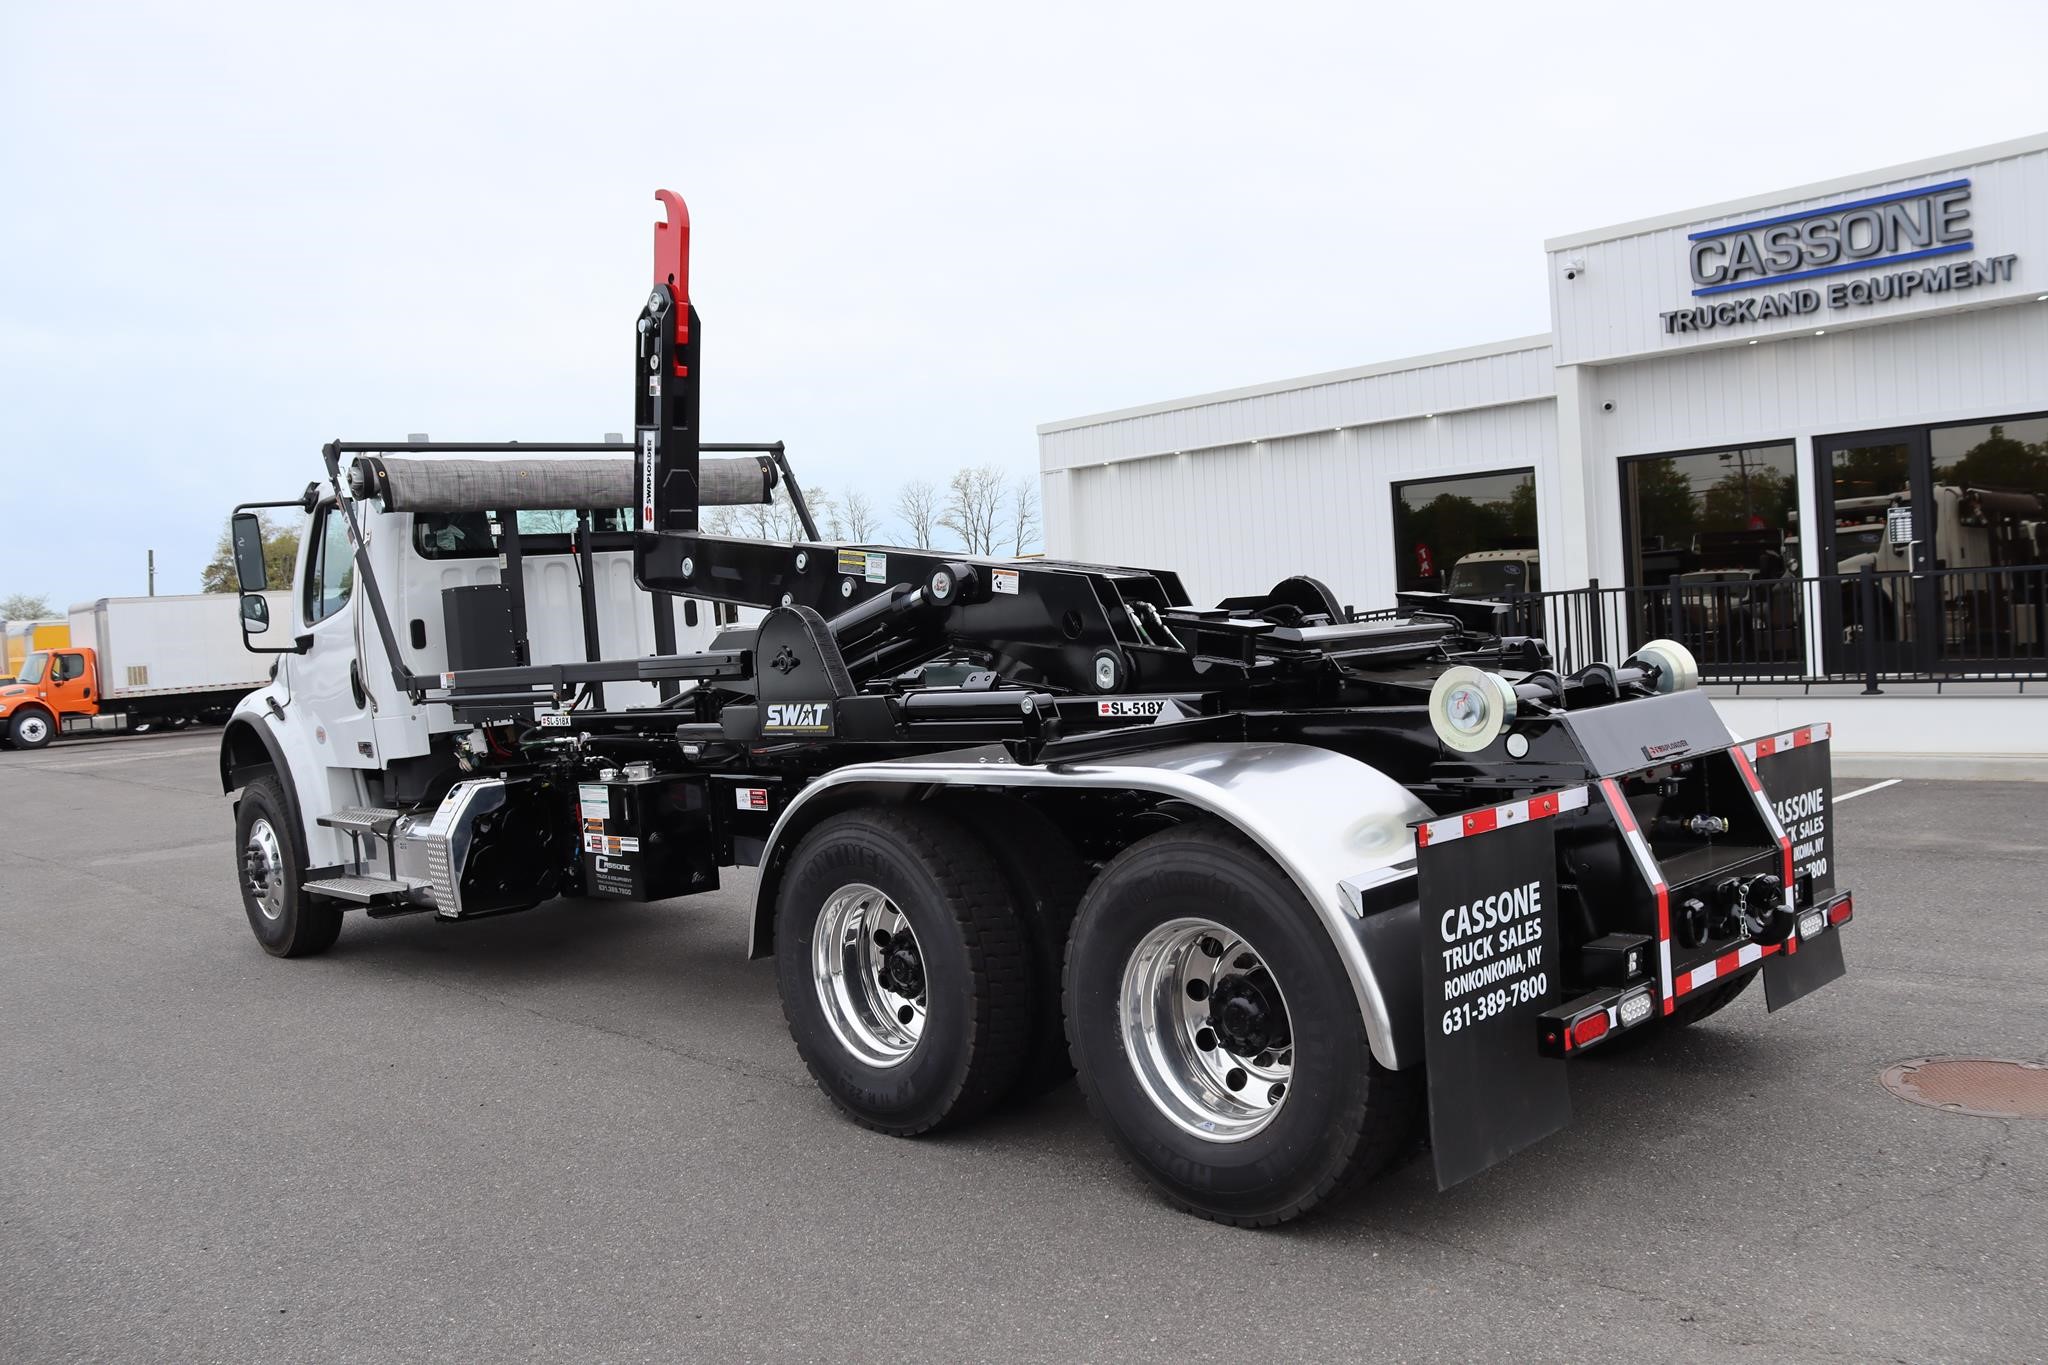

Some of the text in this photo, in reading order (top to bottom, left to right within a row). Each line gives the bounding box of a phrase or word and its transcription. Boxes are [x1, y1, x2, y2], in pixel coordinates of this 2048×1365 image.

[1689, 189, 1973, 286] CASSONE
[1659, 253, 2018, 335] TRUCK AND EQUIPMENT
[546, 717, 570, 726] SL-518X
[766, 703, 828, 726] SWAT
[1772, 787, 1824, 825] ASSONE
[1799, 815, 1824, 840] SALES
[1815, 837, 1825, 853] NY
[1441, 881, 1542, 943] CASSONE
[1443, 918, 1543, 973] TRUCK SALES
[1444, 946, 1543, 1001] RONKONKOMA, NY
[1442, 972, 1547, 1036] 631-389-7800
